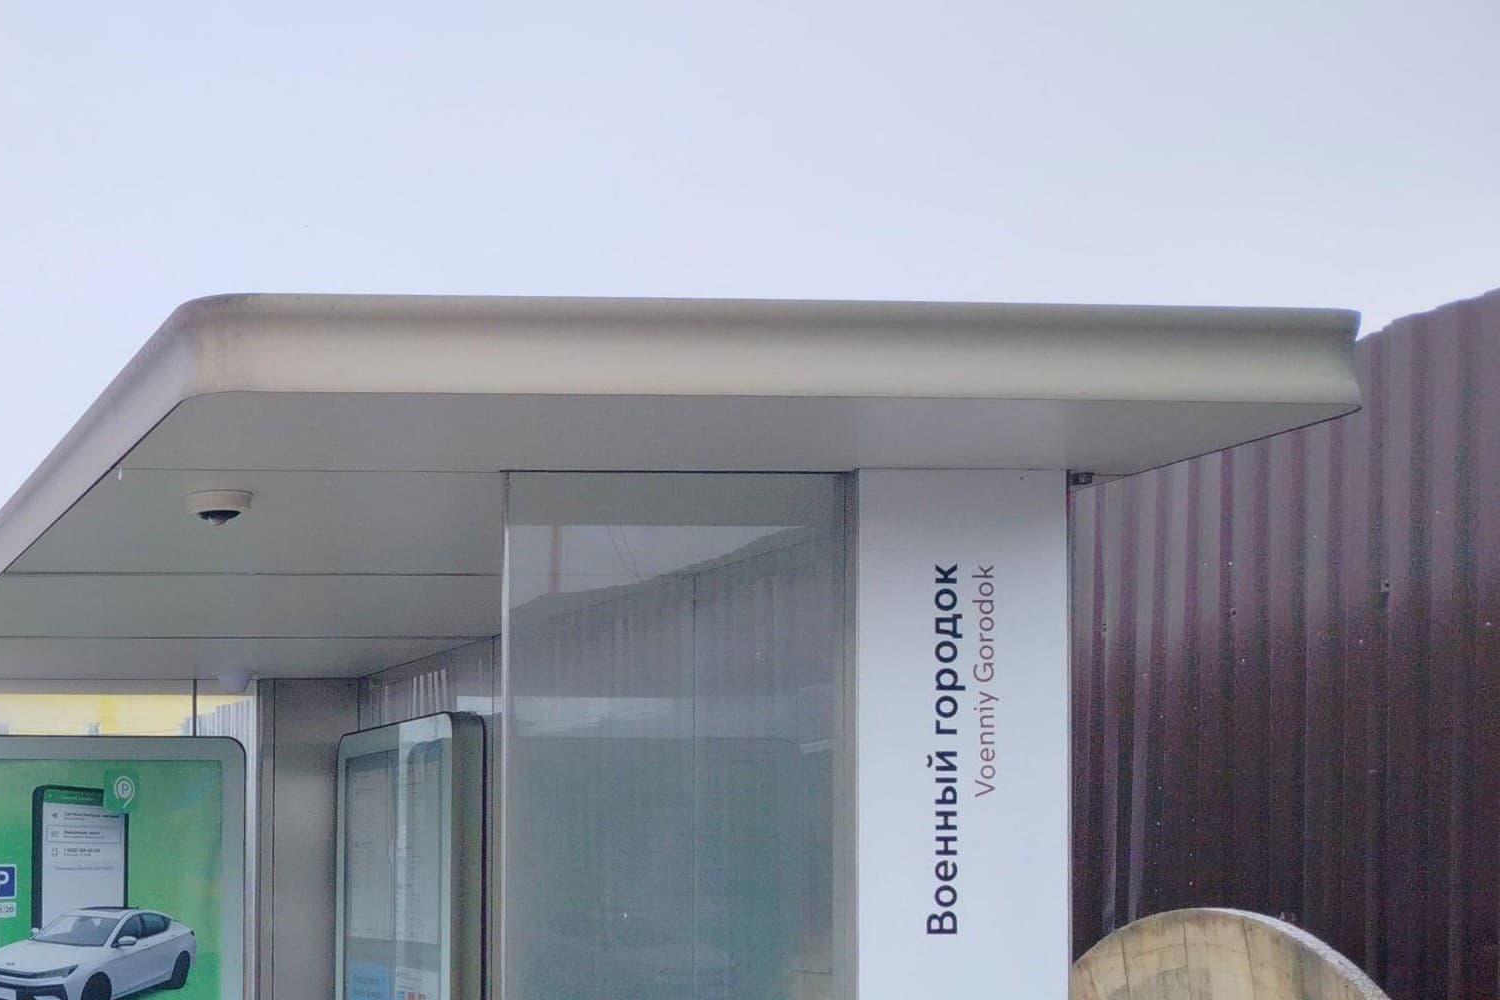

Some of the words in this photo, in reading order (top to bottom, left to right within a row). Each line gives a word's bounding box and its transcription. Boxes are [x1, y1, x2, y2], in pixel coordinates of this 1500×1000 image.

[933, 563, 965, 736] городок
[972, 564, 995, 683] Gorodok
[973, 692, 999, 798] Voenniy
[926, 749, 958, 935] Военный
